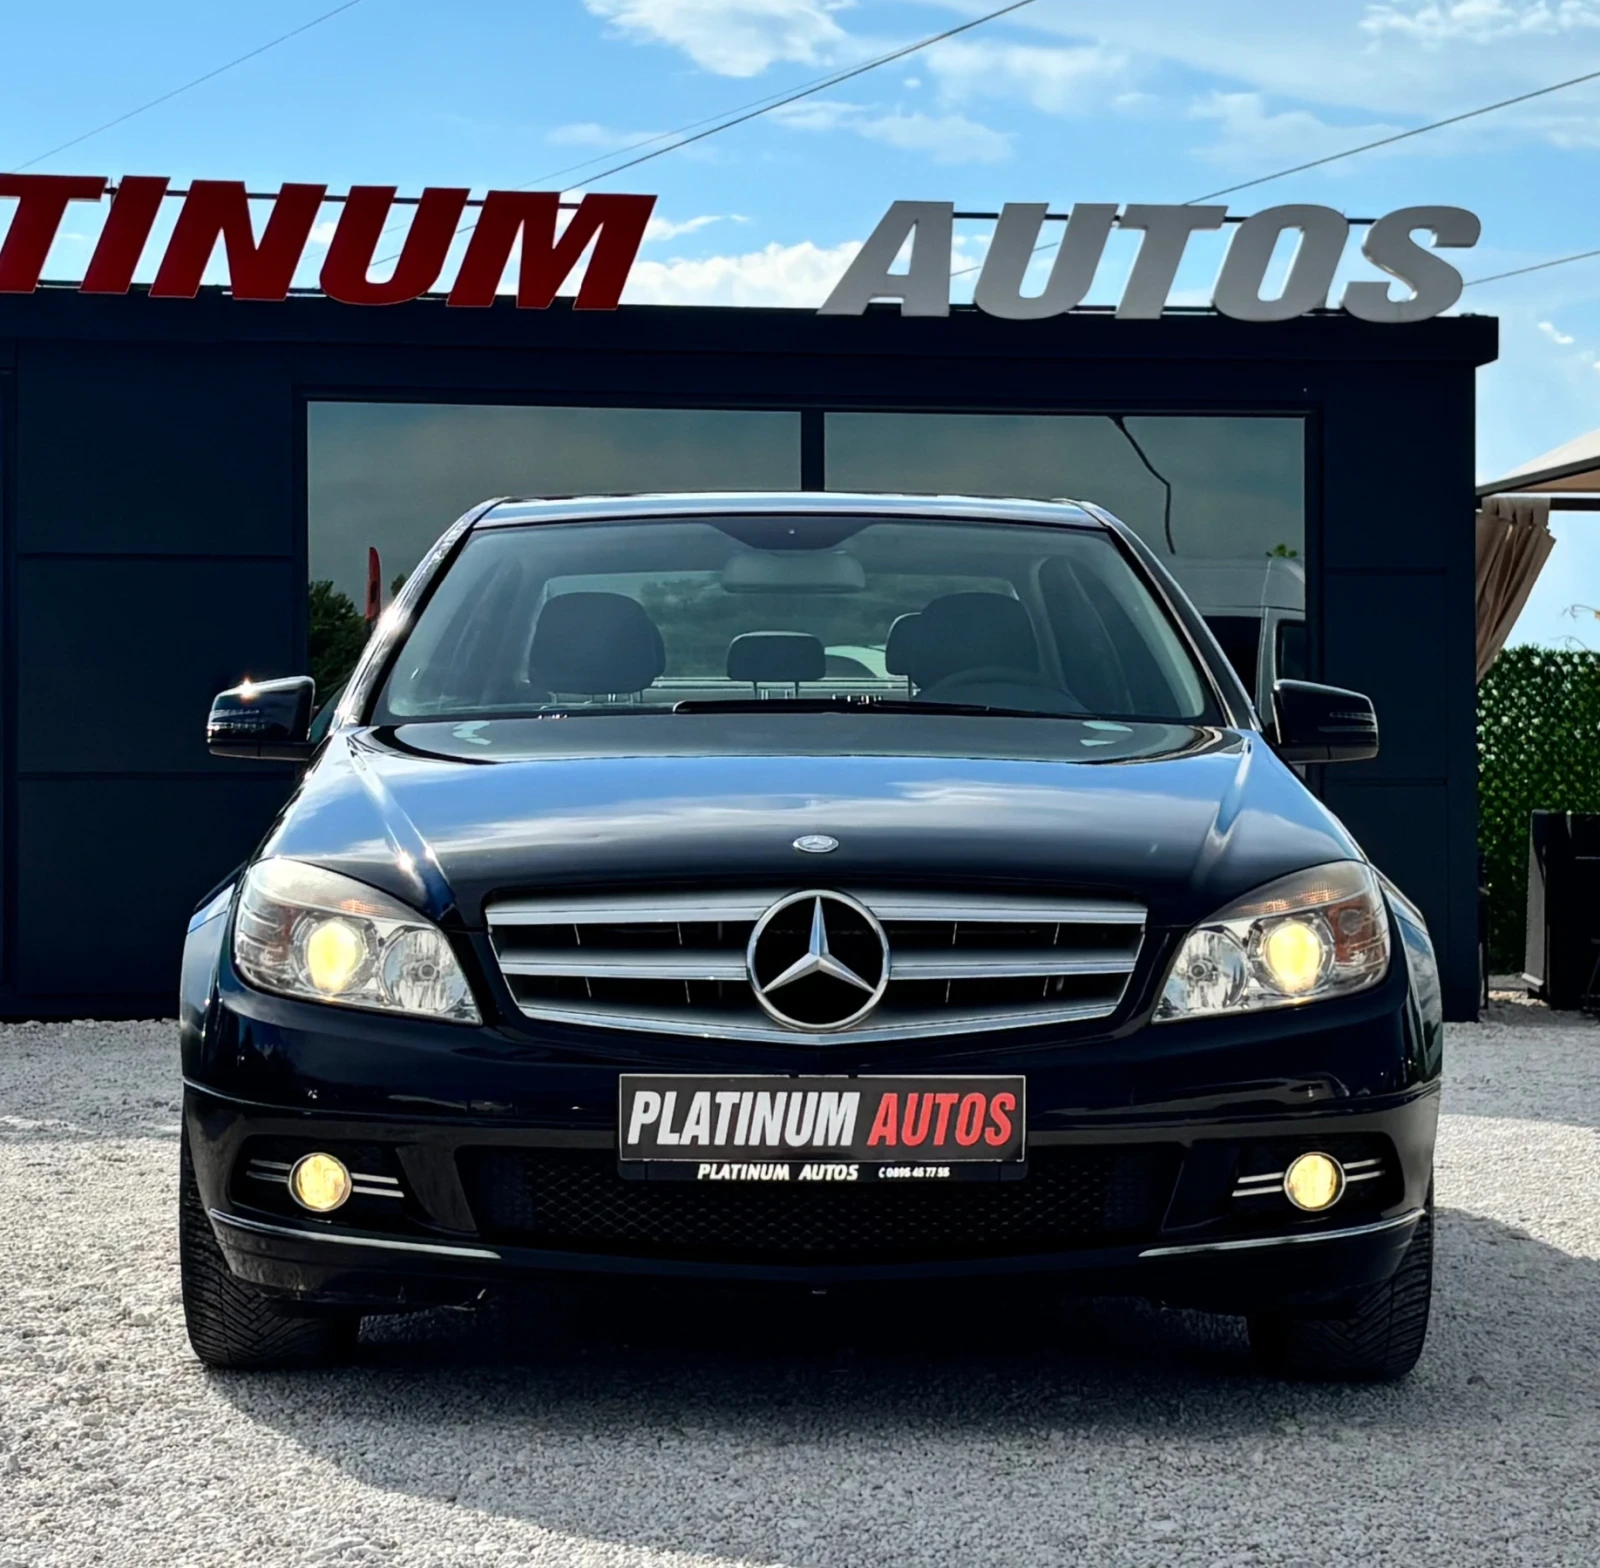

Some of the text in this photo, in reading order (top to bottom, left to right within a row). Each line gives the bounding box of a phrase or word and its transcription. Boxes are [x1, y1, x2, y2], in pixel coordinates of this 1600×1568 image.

[816, 200, 1481, 323] AUTOS
[627, 1090, 1016, 1148] PLATINUM AUTOS
[697, 1164, 790, 1180] PLATINUM
[798, 1164, 859, 1180] AUTOS
[925, 1166, 937, 1178] 77
